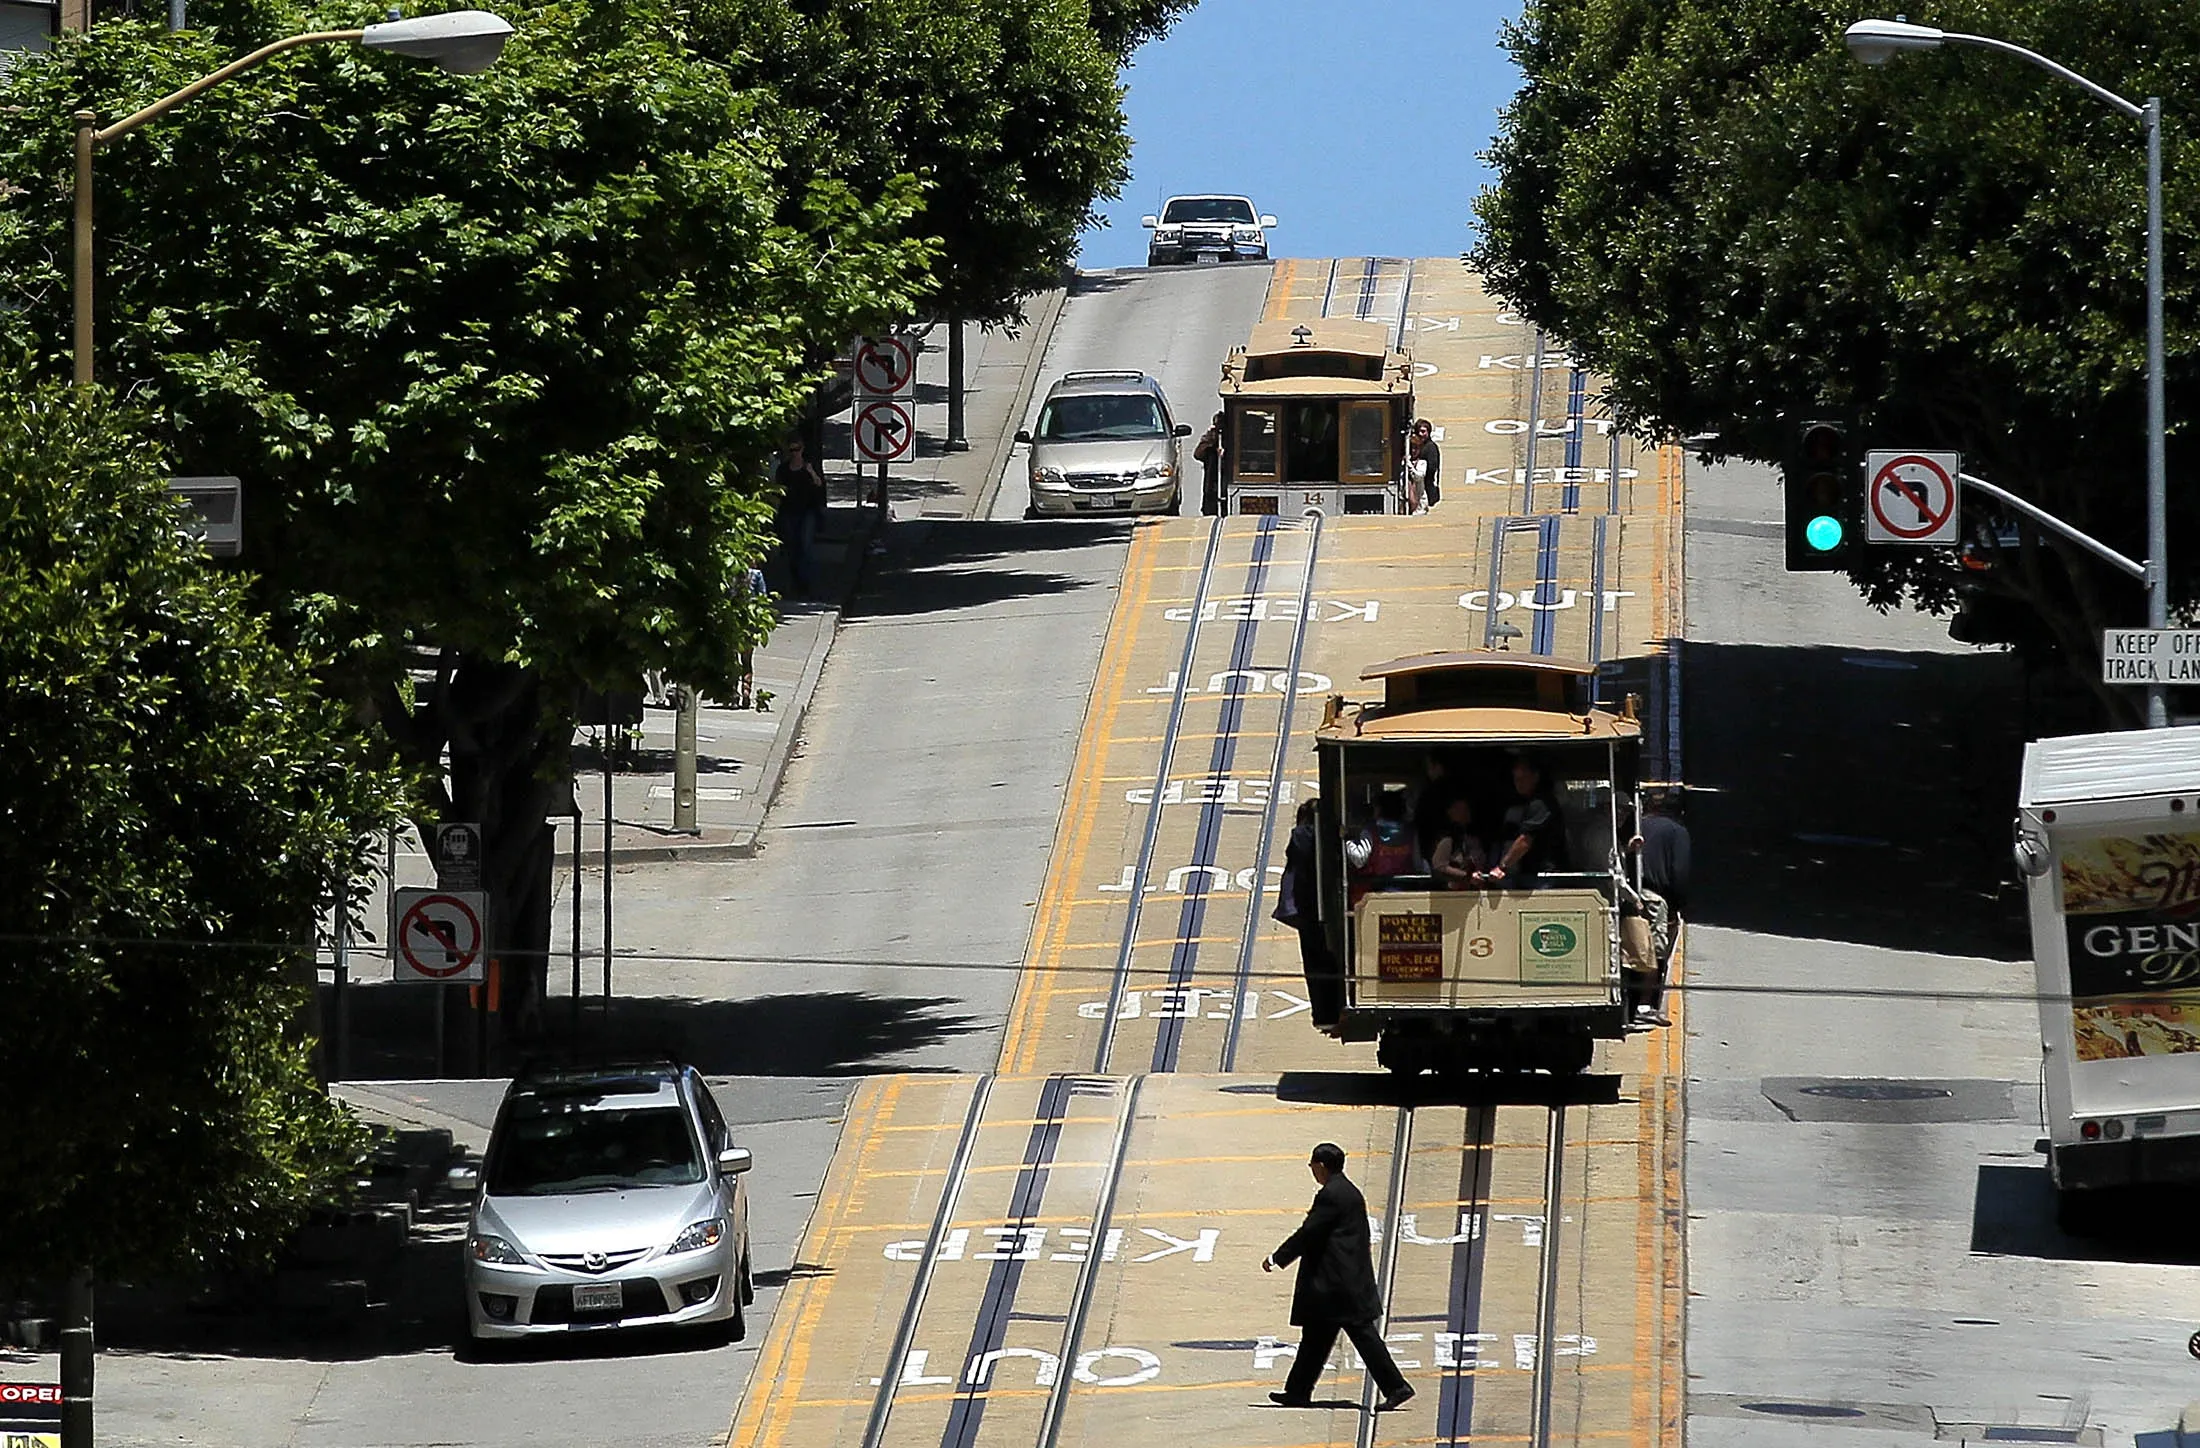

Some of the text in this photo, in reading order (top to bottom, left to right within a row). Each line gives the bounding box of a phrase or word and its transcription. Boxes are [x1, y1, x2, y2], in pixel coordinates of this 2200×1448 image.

[1465, 467, 1640, 485] KEEP
[1303, 492, 1325, 505] 14
[1164, 600, 1380, 622] KEEP
[1458, 589, 1636, 612] OUT
[2116, 634, 2158, 654] KEEP
[2106, 659, 2158, 680] TRACK
[1146, 671, 1332, 694] OUT
[1098, 865, 1288, 893] OUT
[1470, 937, 1494, 958] 3
[1369, 1213, 1573, 1247] UT
[883, 1228, 1221, 1263] KEEP
[870, 1347, 1161, 1386] OUT
